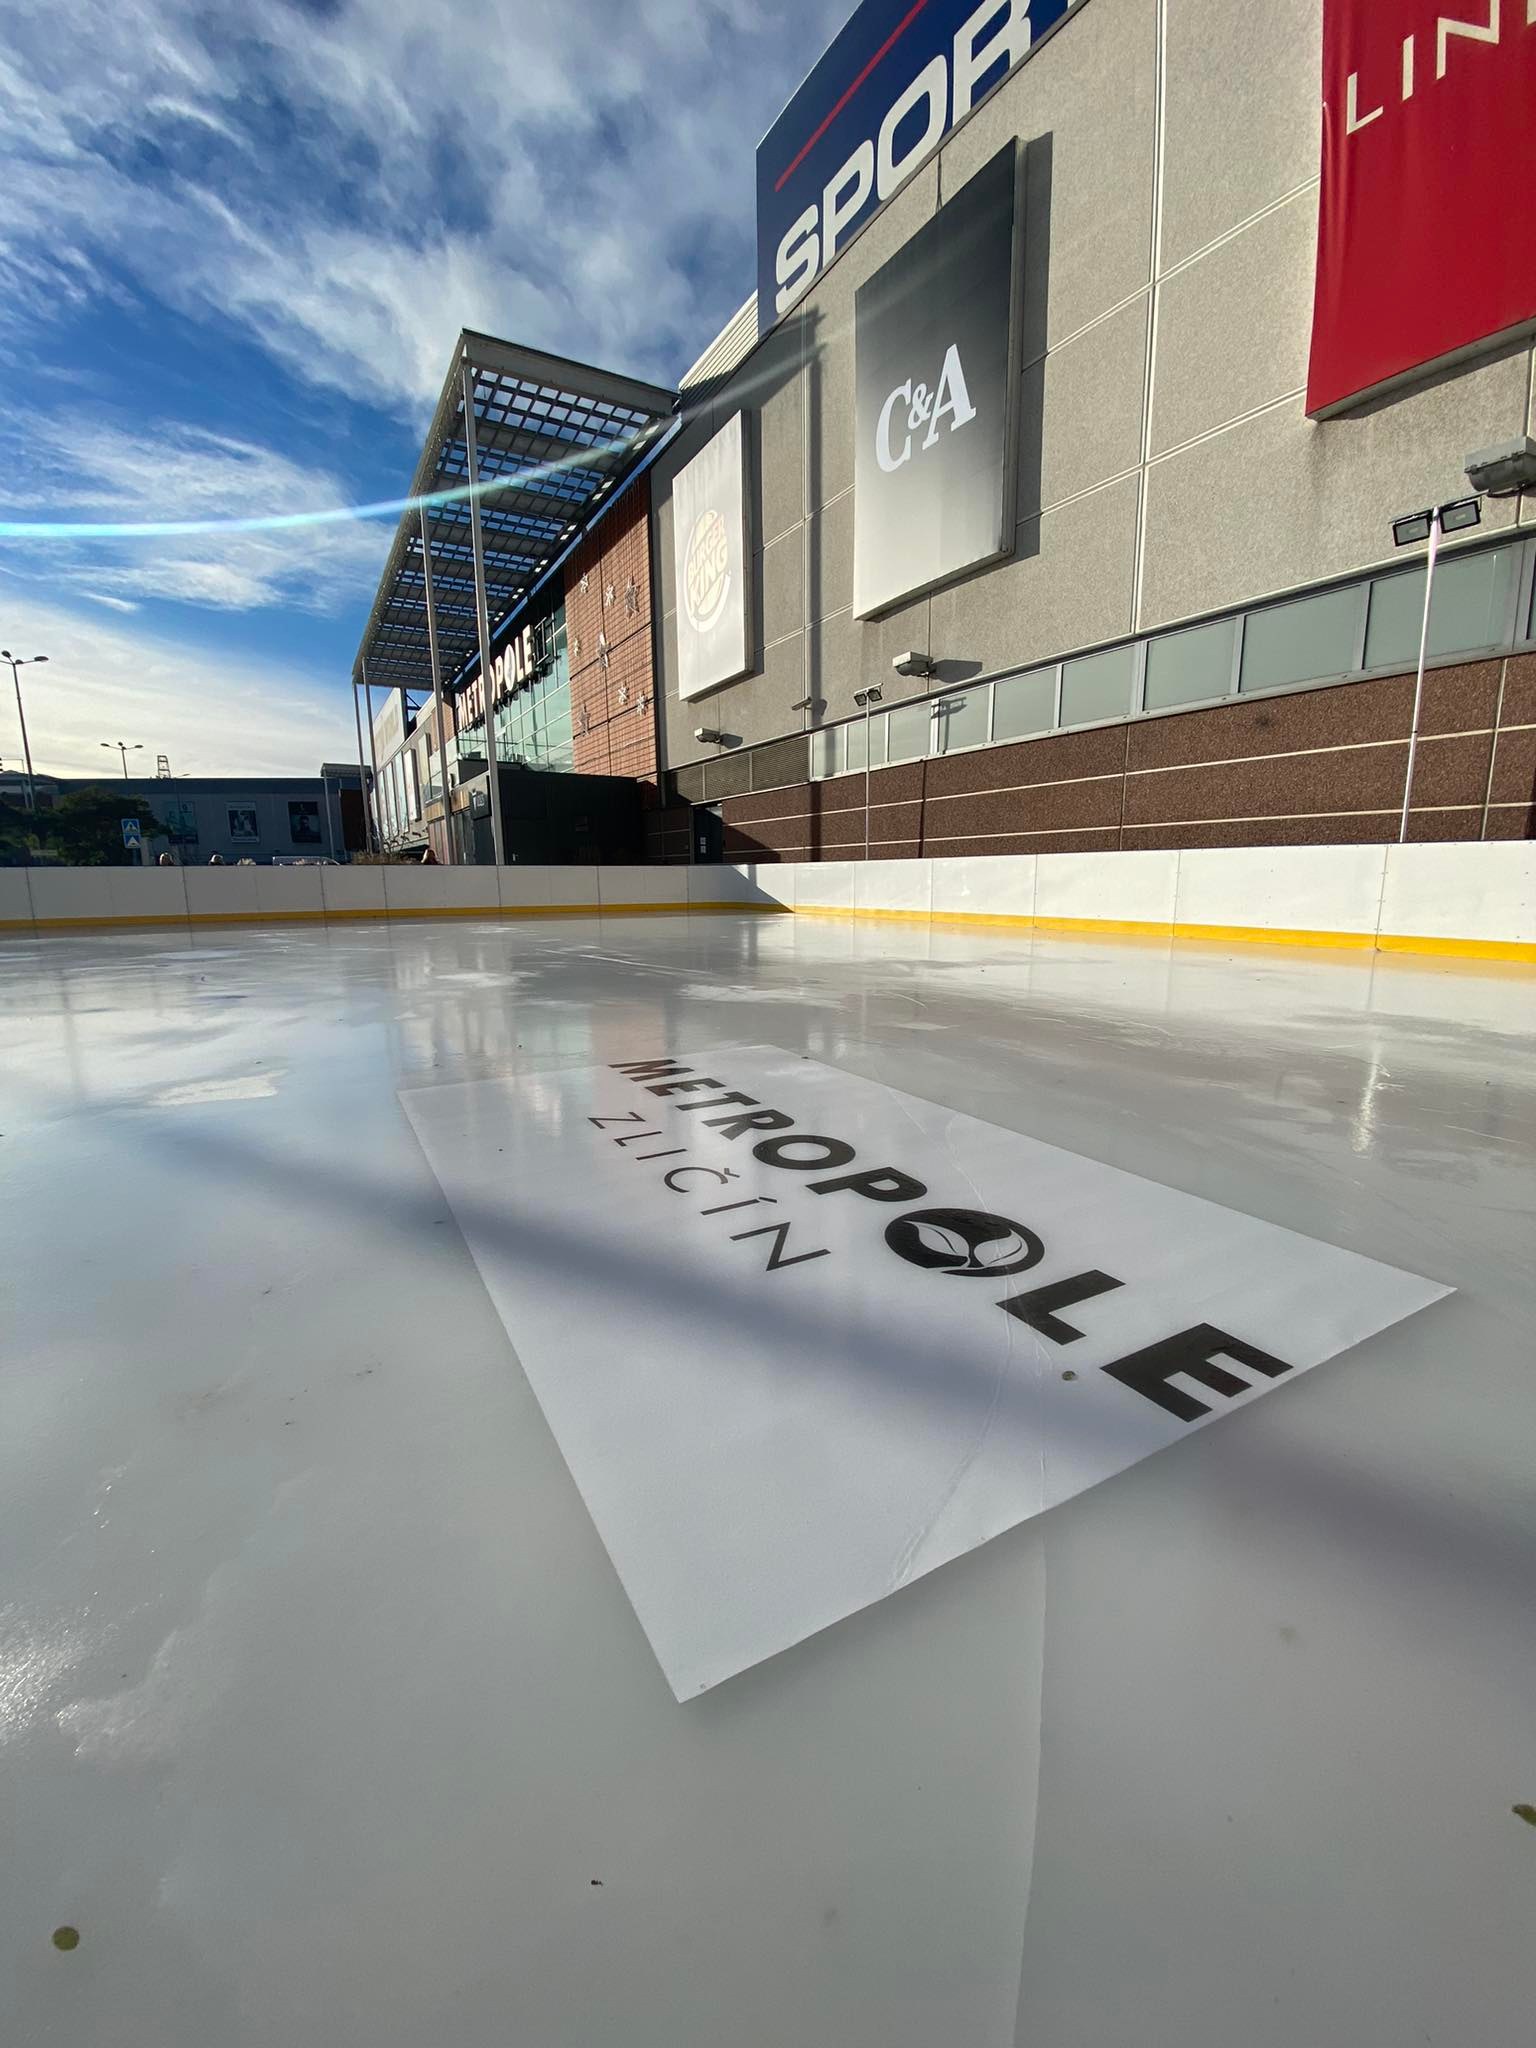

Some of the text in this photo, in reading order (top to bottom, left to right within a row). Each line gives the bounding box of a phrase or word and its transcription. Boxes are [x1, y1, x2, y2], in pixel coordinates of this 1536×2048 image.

[1346, 0, 1536, 136] LIN
[775, 0, 1079, 315] SPOR
[876, 343, 977, 472] C&A
[687, 512, 726, 581] BURGER
[688, 534, 729, 616] KING
[587, 1111, 831, 1271] ZLIČÍN
[608, 1059, 1294, 1423] METROPOLE
